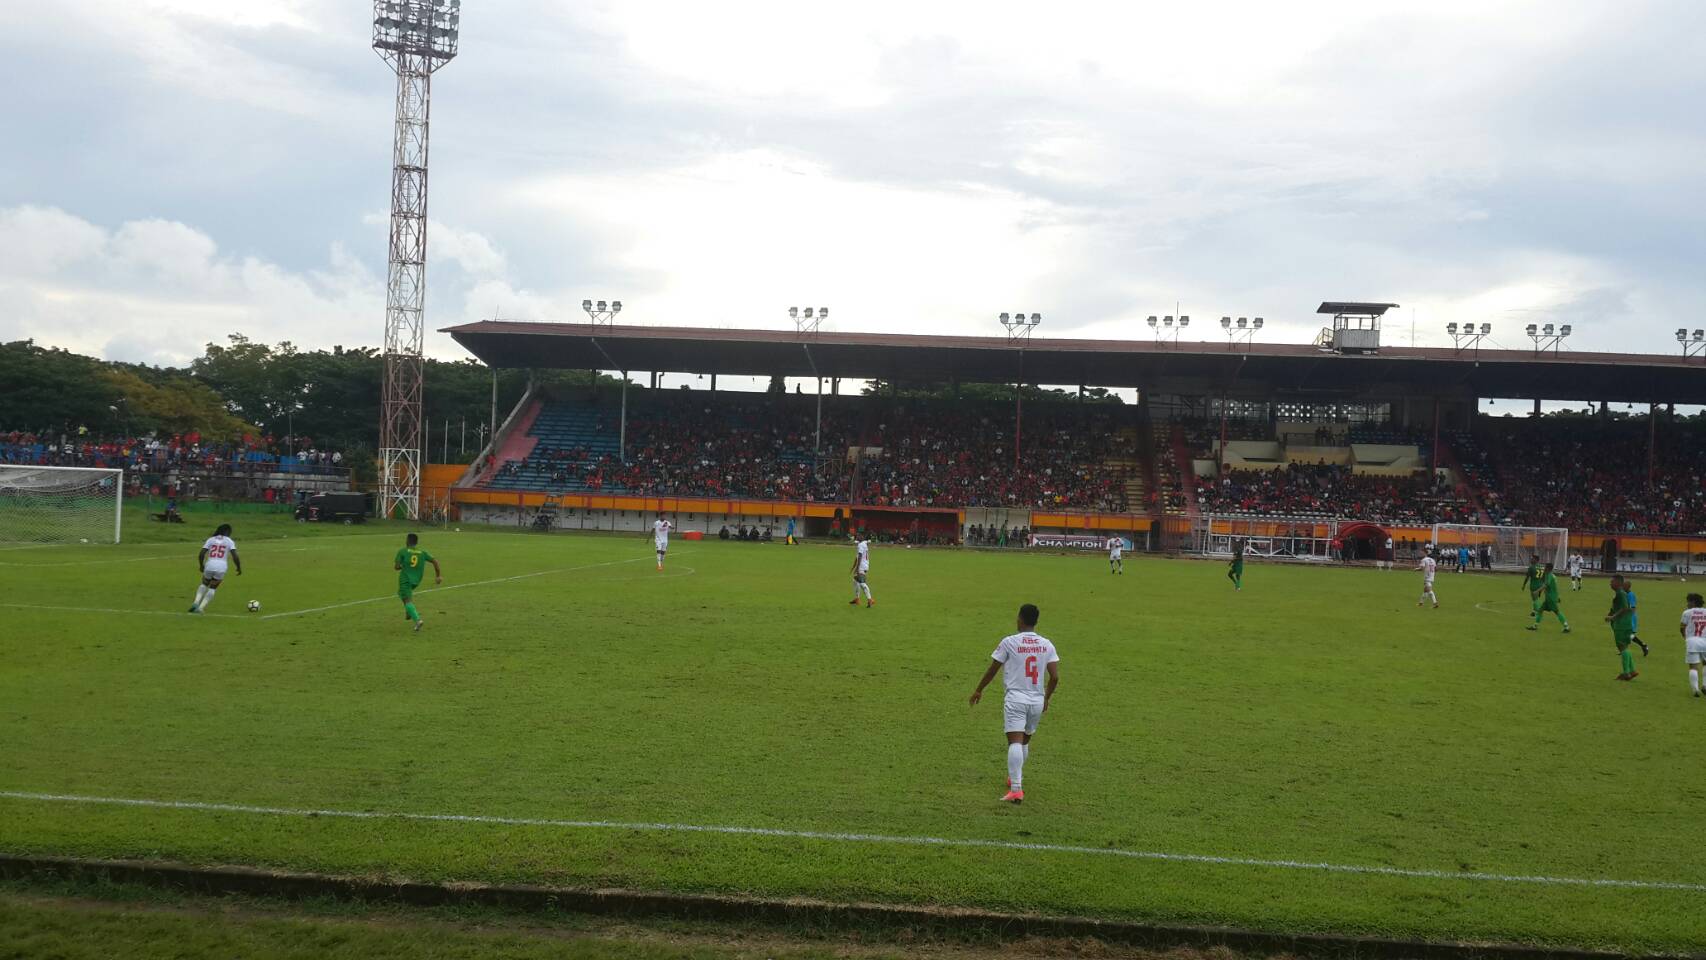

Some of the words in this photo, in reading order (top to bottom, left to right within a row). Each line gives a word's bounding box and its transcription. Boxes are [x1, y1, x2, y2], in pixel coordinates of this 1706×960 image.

[209, 544, 226, 558] 25
[411, 555, 417, 568] 9
[1535, 569, 1545, 578] 27
[1694, 621, 1706, 637] 17
[1025, 656, 1038, 684] 4
